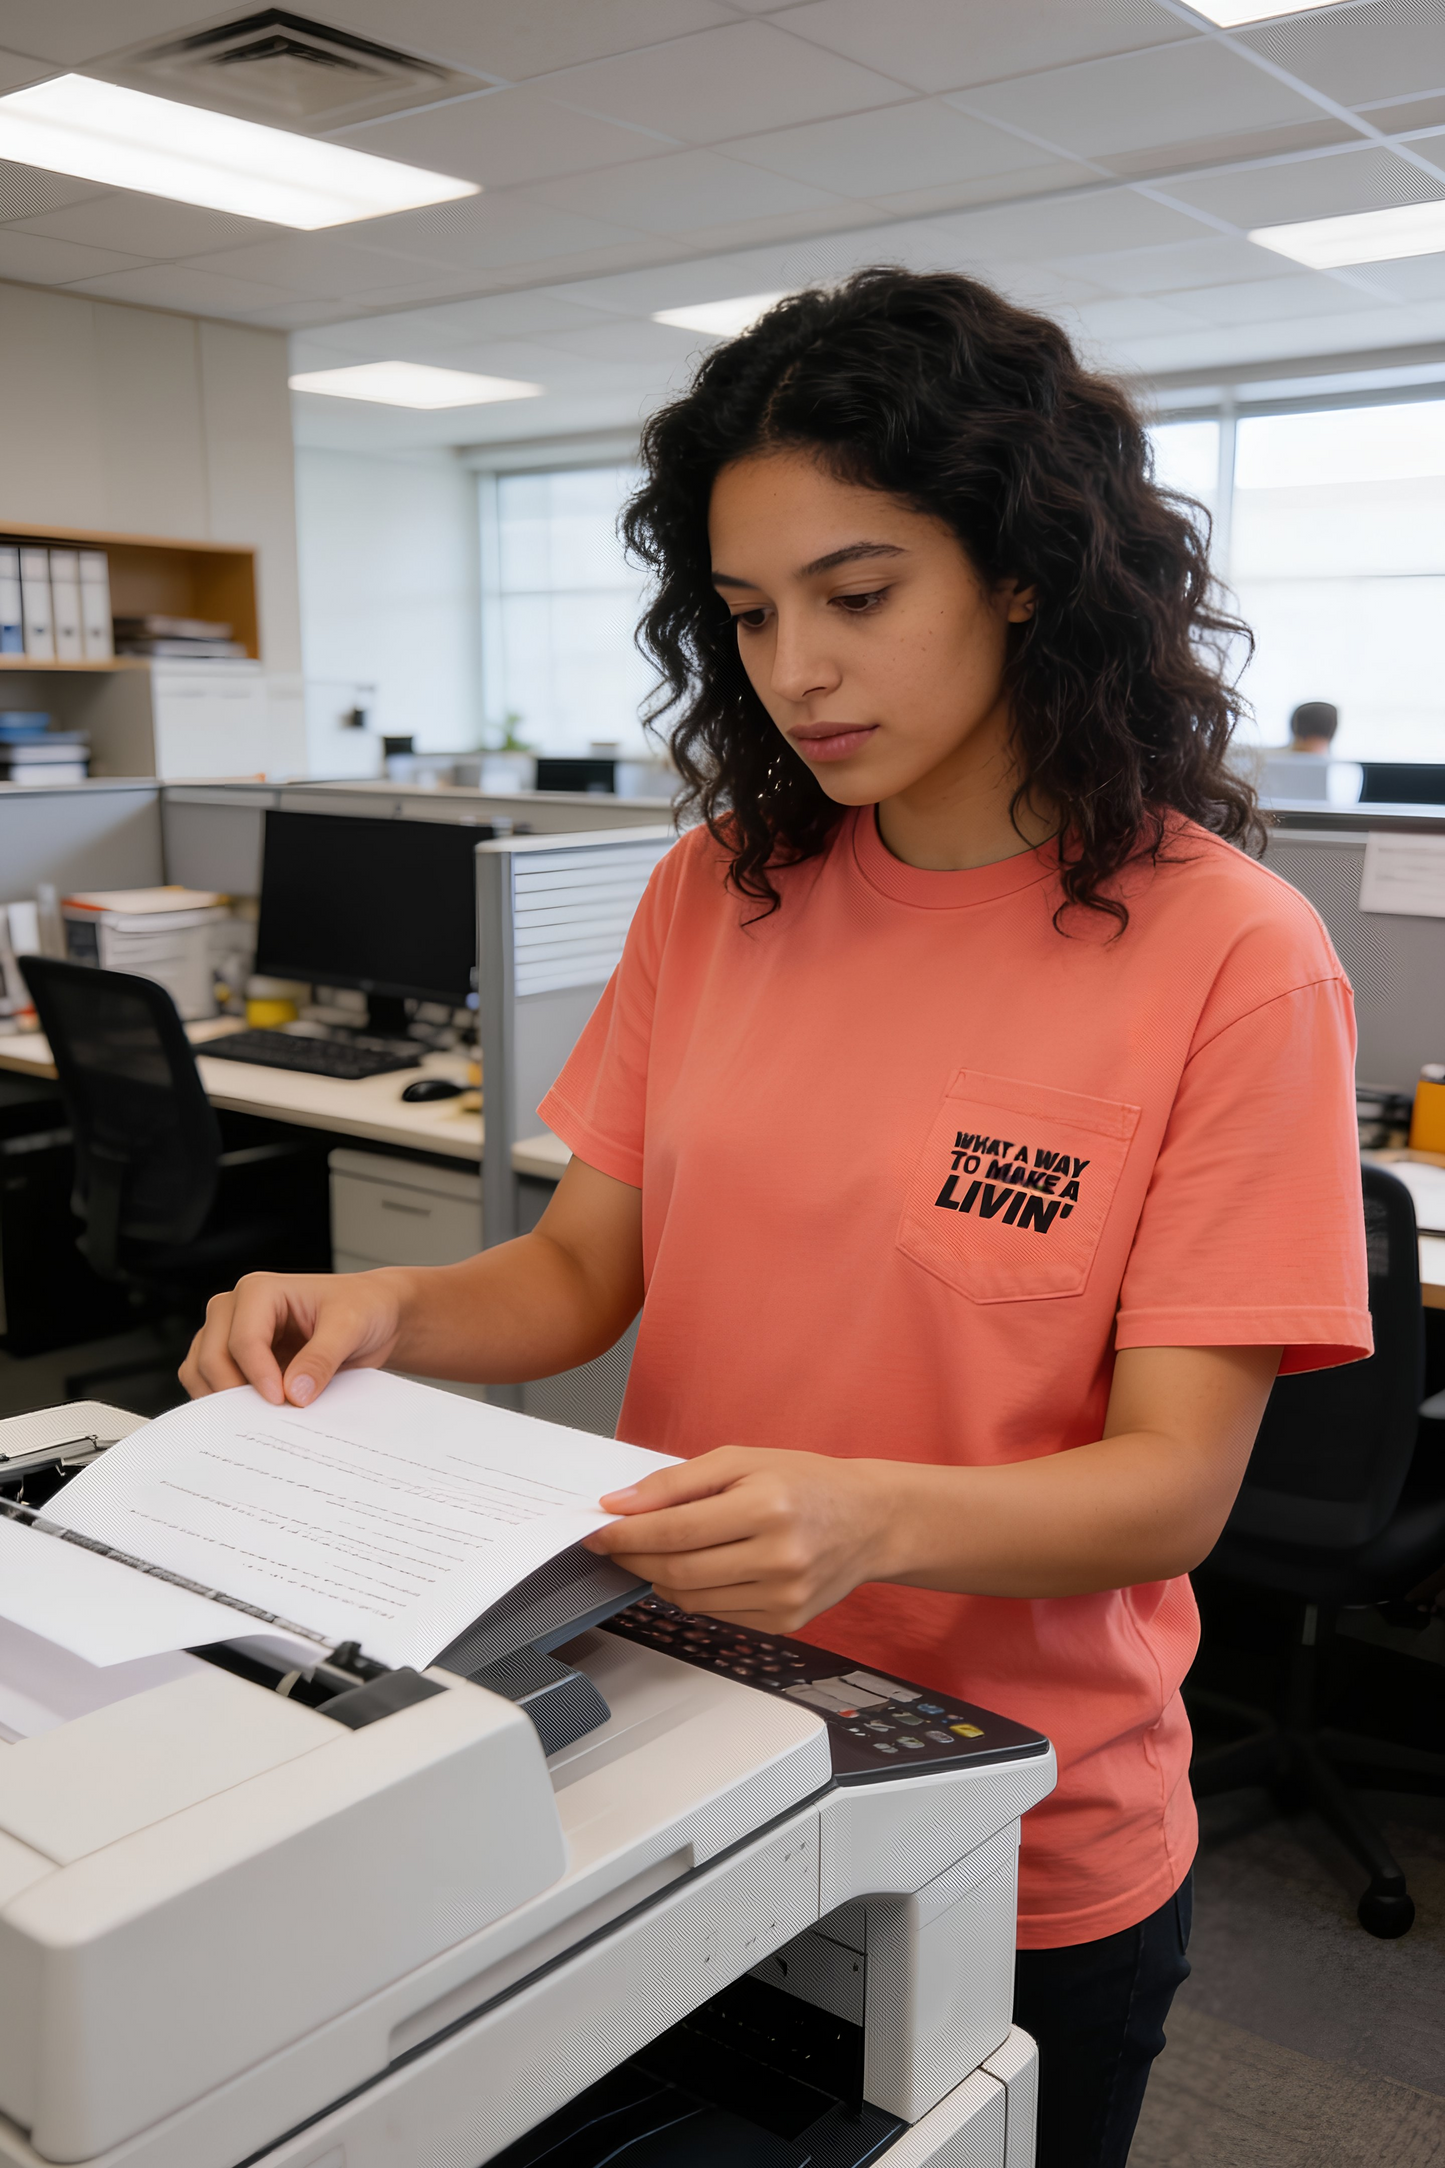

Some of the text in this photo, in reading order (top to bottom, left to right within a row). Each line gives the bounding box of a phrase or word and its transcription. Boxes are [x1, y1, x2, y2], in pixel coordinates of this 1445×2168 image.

[951, 1150, 1080, 1202] TO MAKE A
[954, 1131, 1091, 1178] WHAT A WAY
[934, 1174, 1075, 1234] LIVIN'
